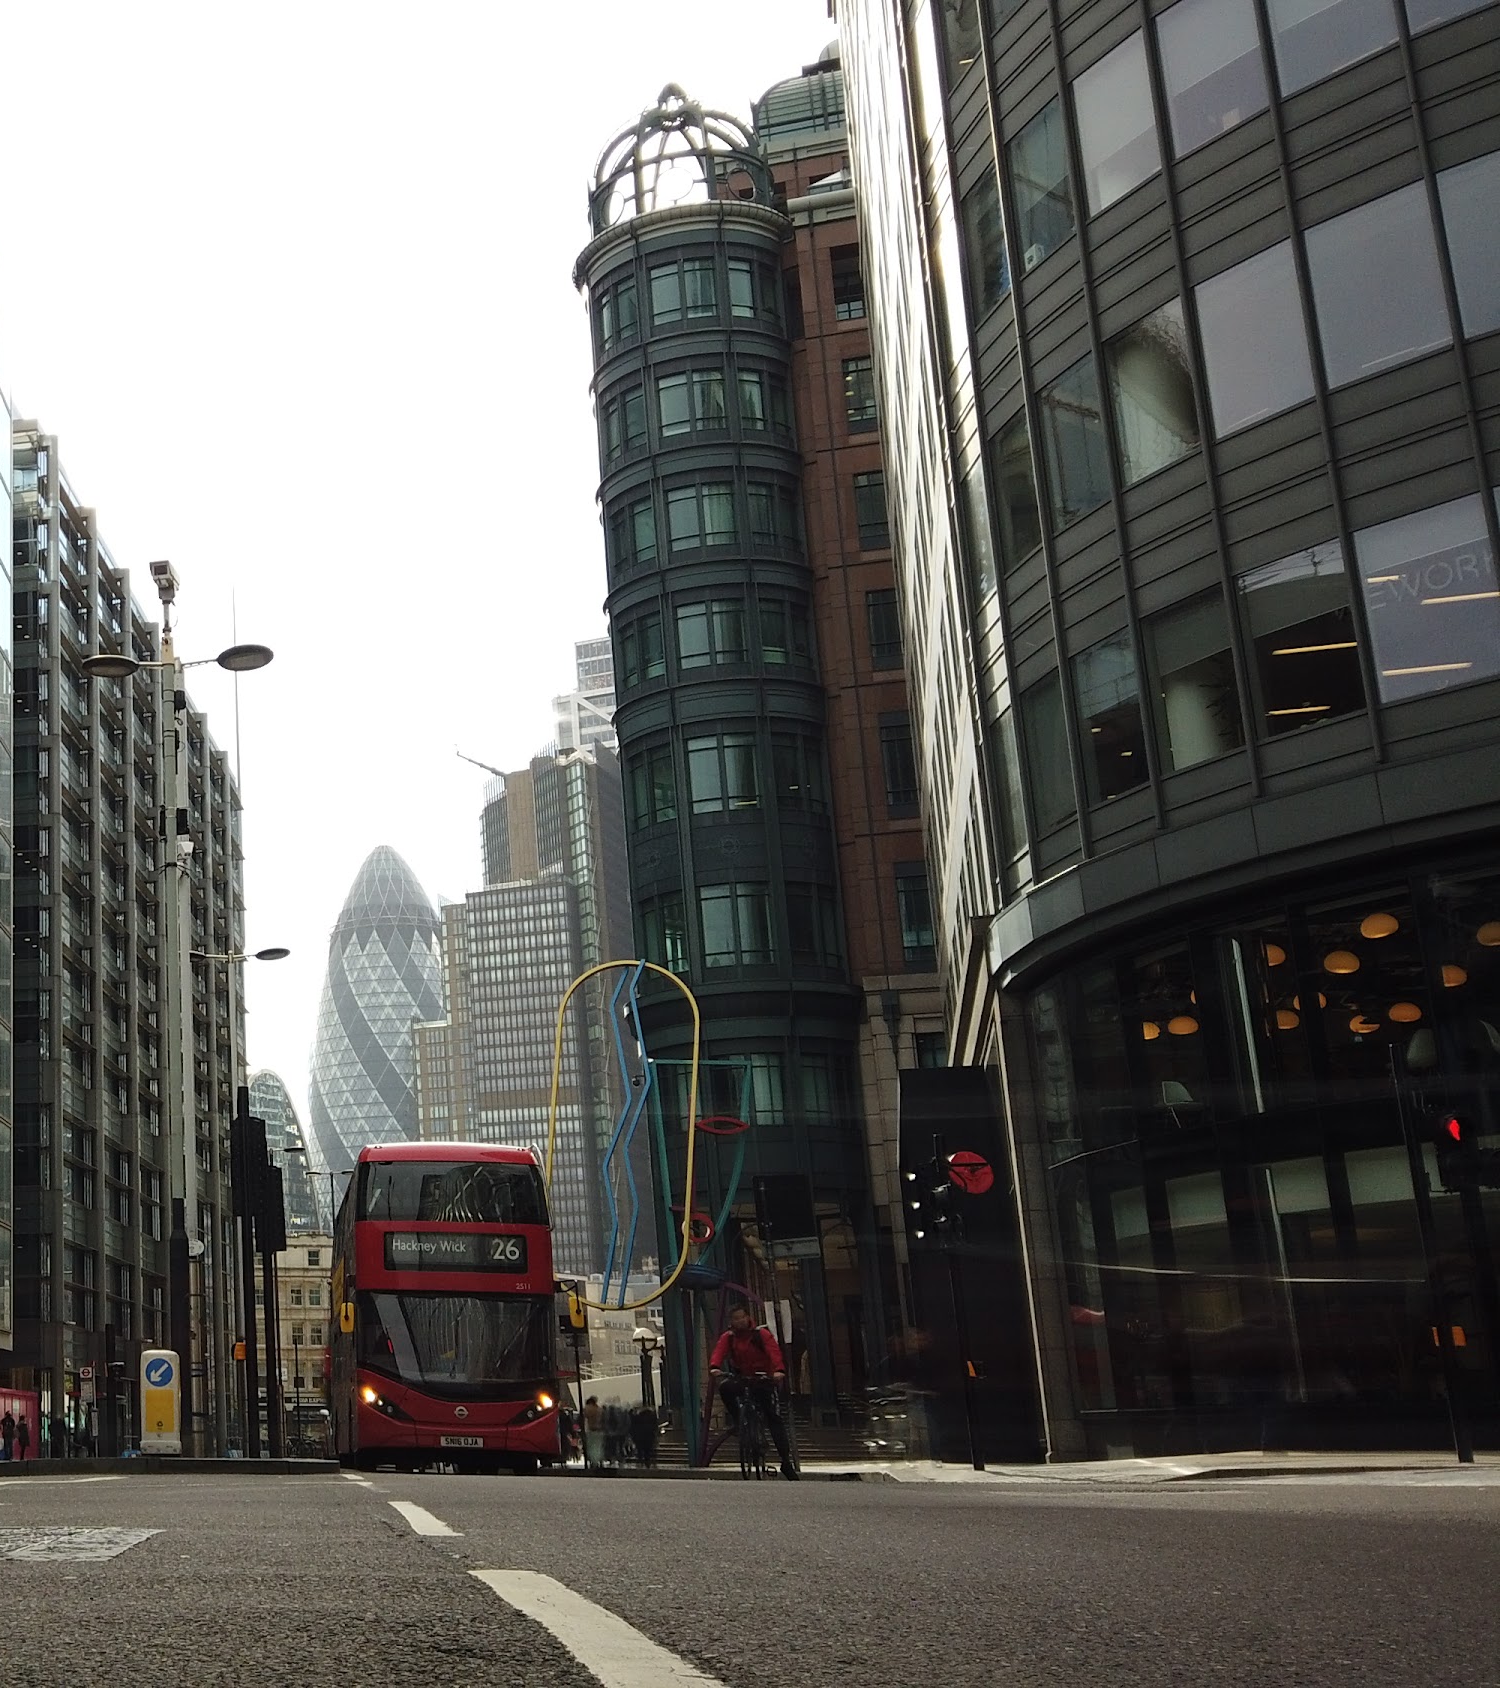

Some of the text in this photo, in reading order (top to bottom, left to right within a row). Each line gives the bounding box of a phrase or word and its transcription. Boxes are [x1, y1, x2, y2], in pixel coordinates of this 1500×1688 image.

[392, 1239, 467, 1254] Hackney Wick
[492, 1238, 520, 1260] 26
[515, 1282, 531, 1290] 2511
